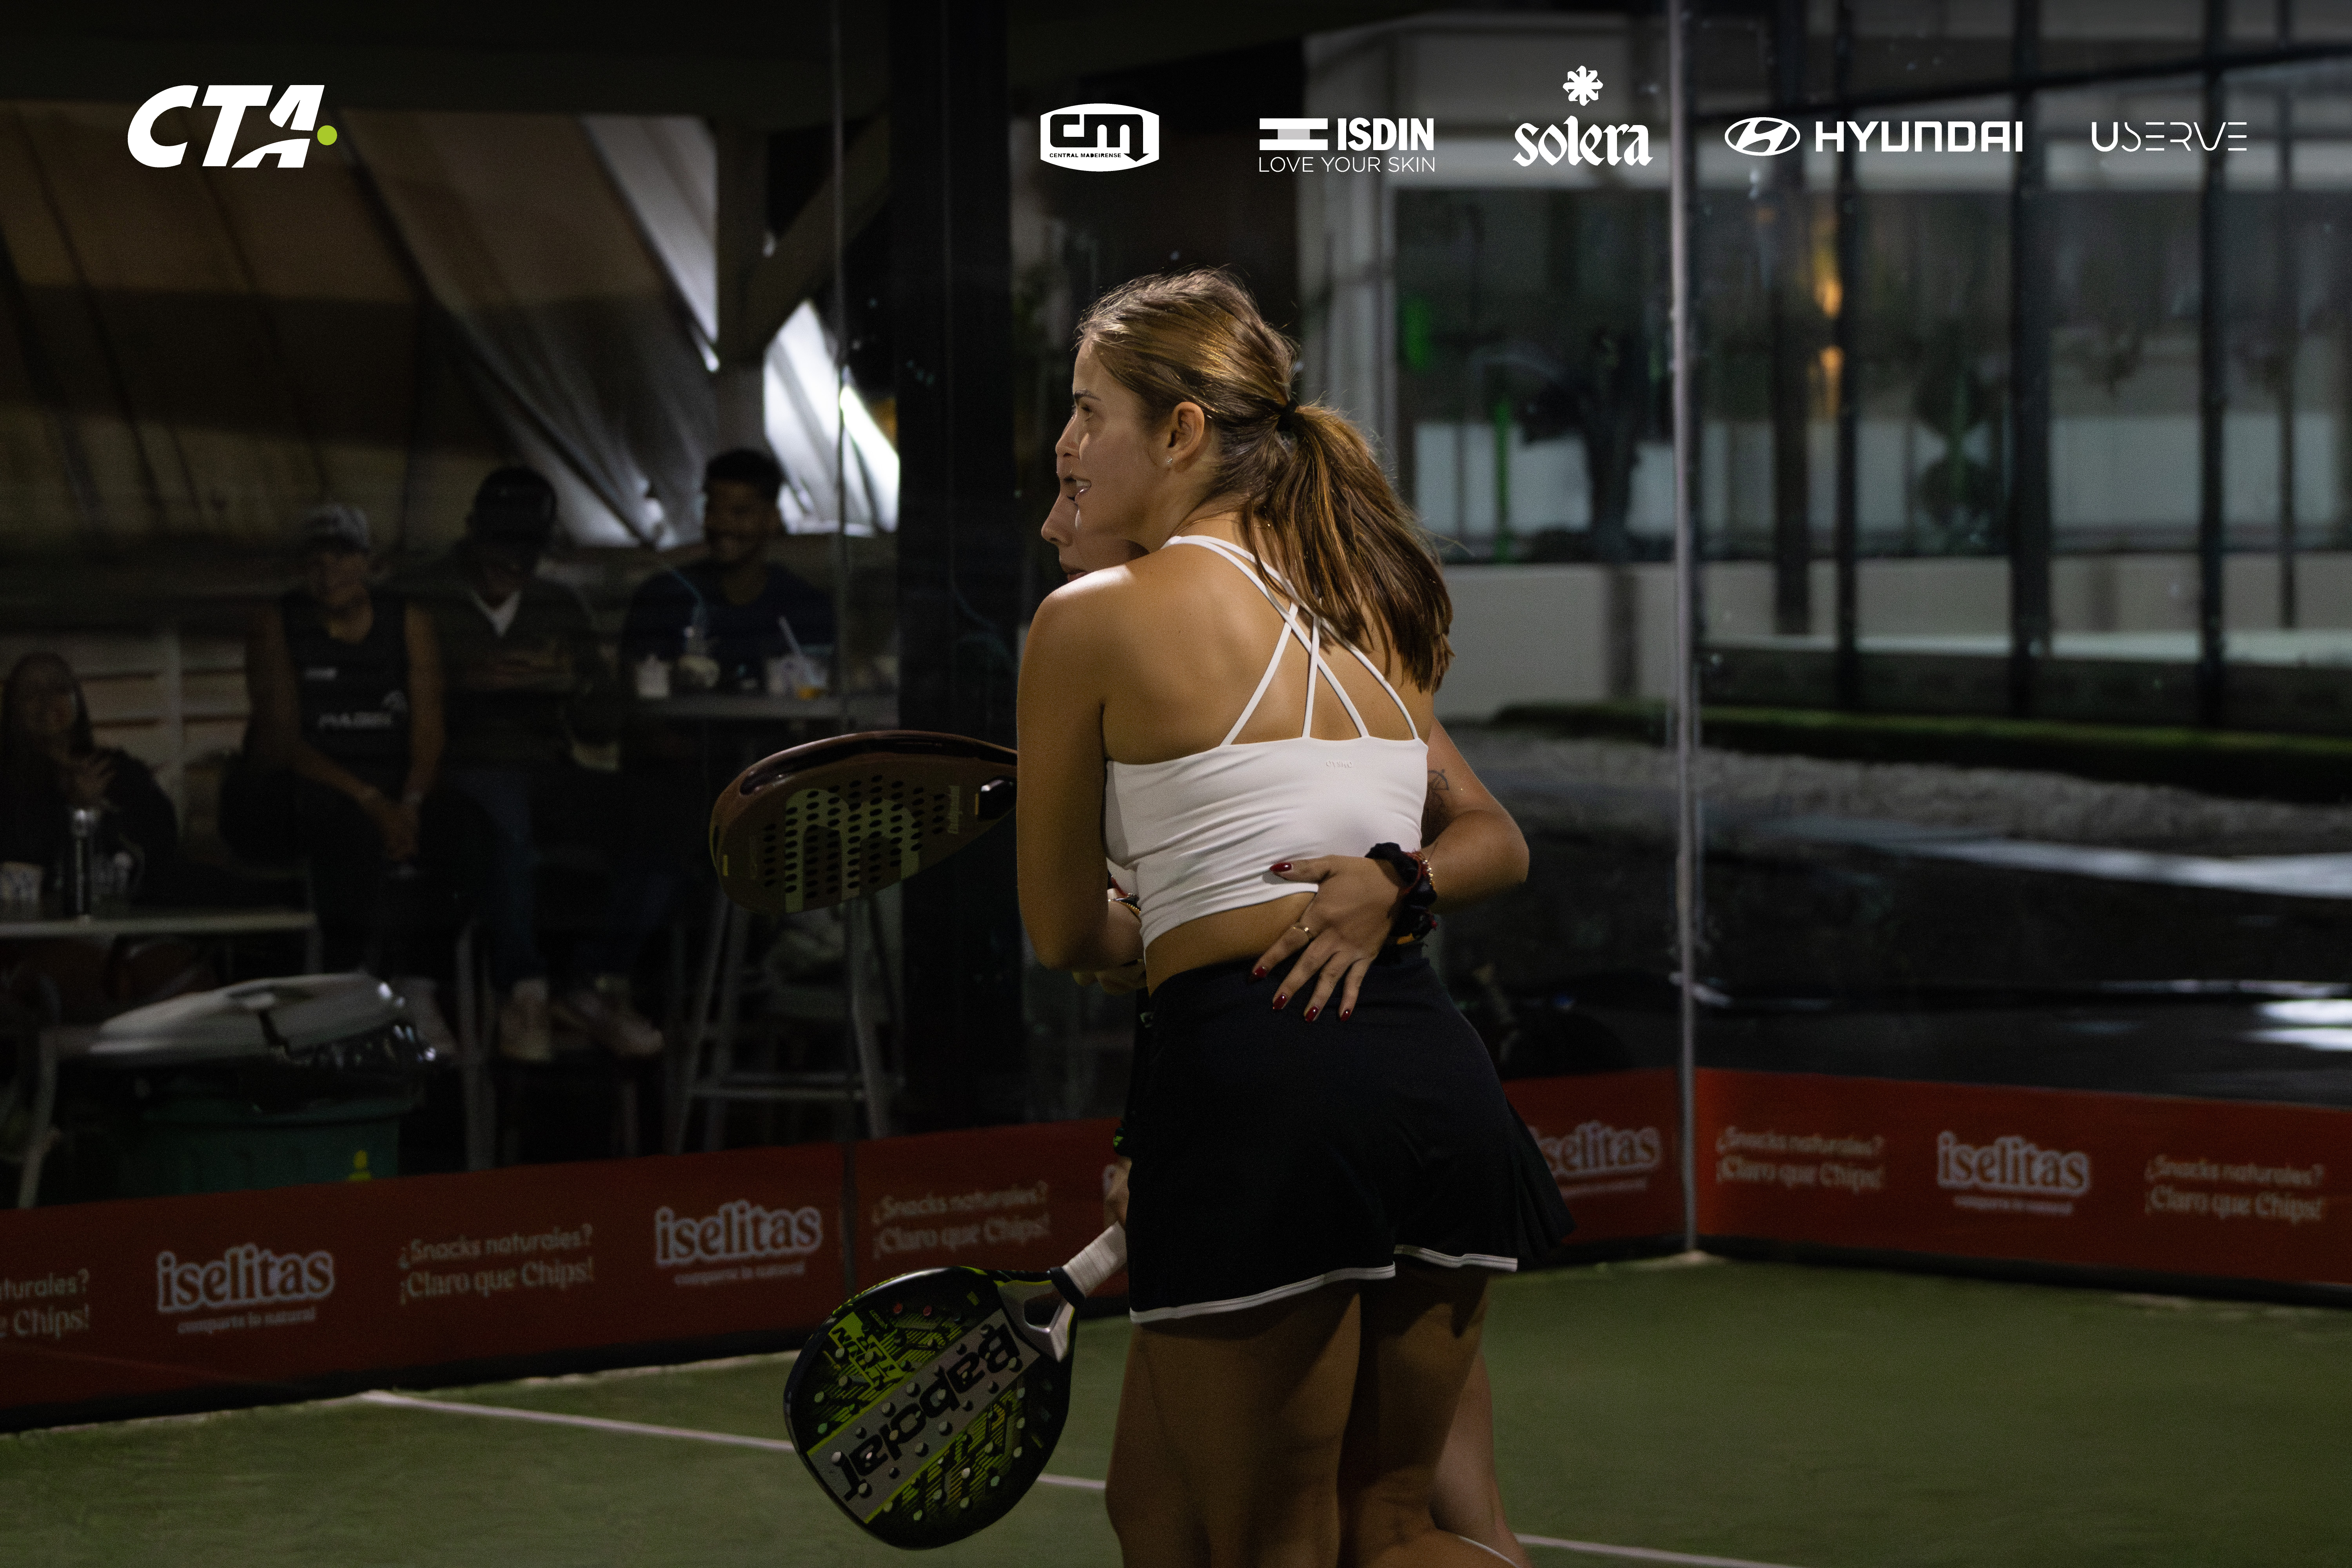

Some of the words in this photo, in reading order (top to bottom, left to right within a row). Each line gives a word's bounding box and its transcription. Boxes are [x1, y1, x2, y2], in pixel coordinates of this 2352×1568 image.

[1937, 1130, 2091, 1198] iselitas
[654, 1198, 823, 1267] iselitas
[0, 1267, 90, 1300] turales?
[156, 1241, 335, 1313] iselitas
[473, 1267, 516, 1298] que
[13, 1303, 89, 1340] Chips!
[839, 1323, 1020, 1501] Babolat
